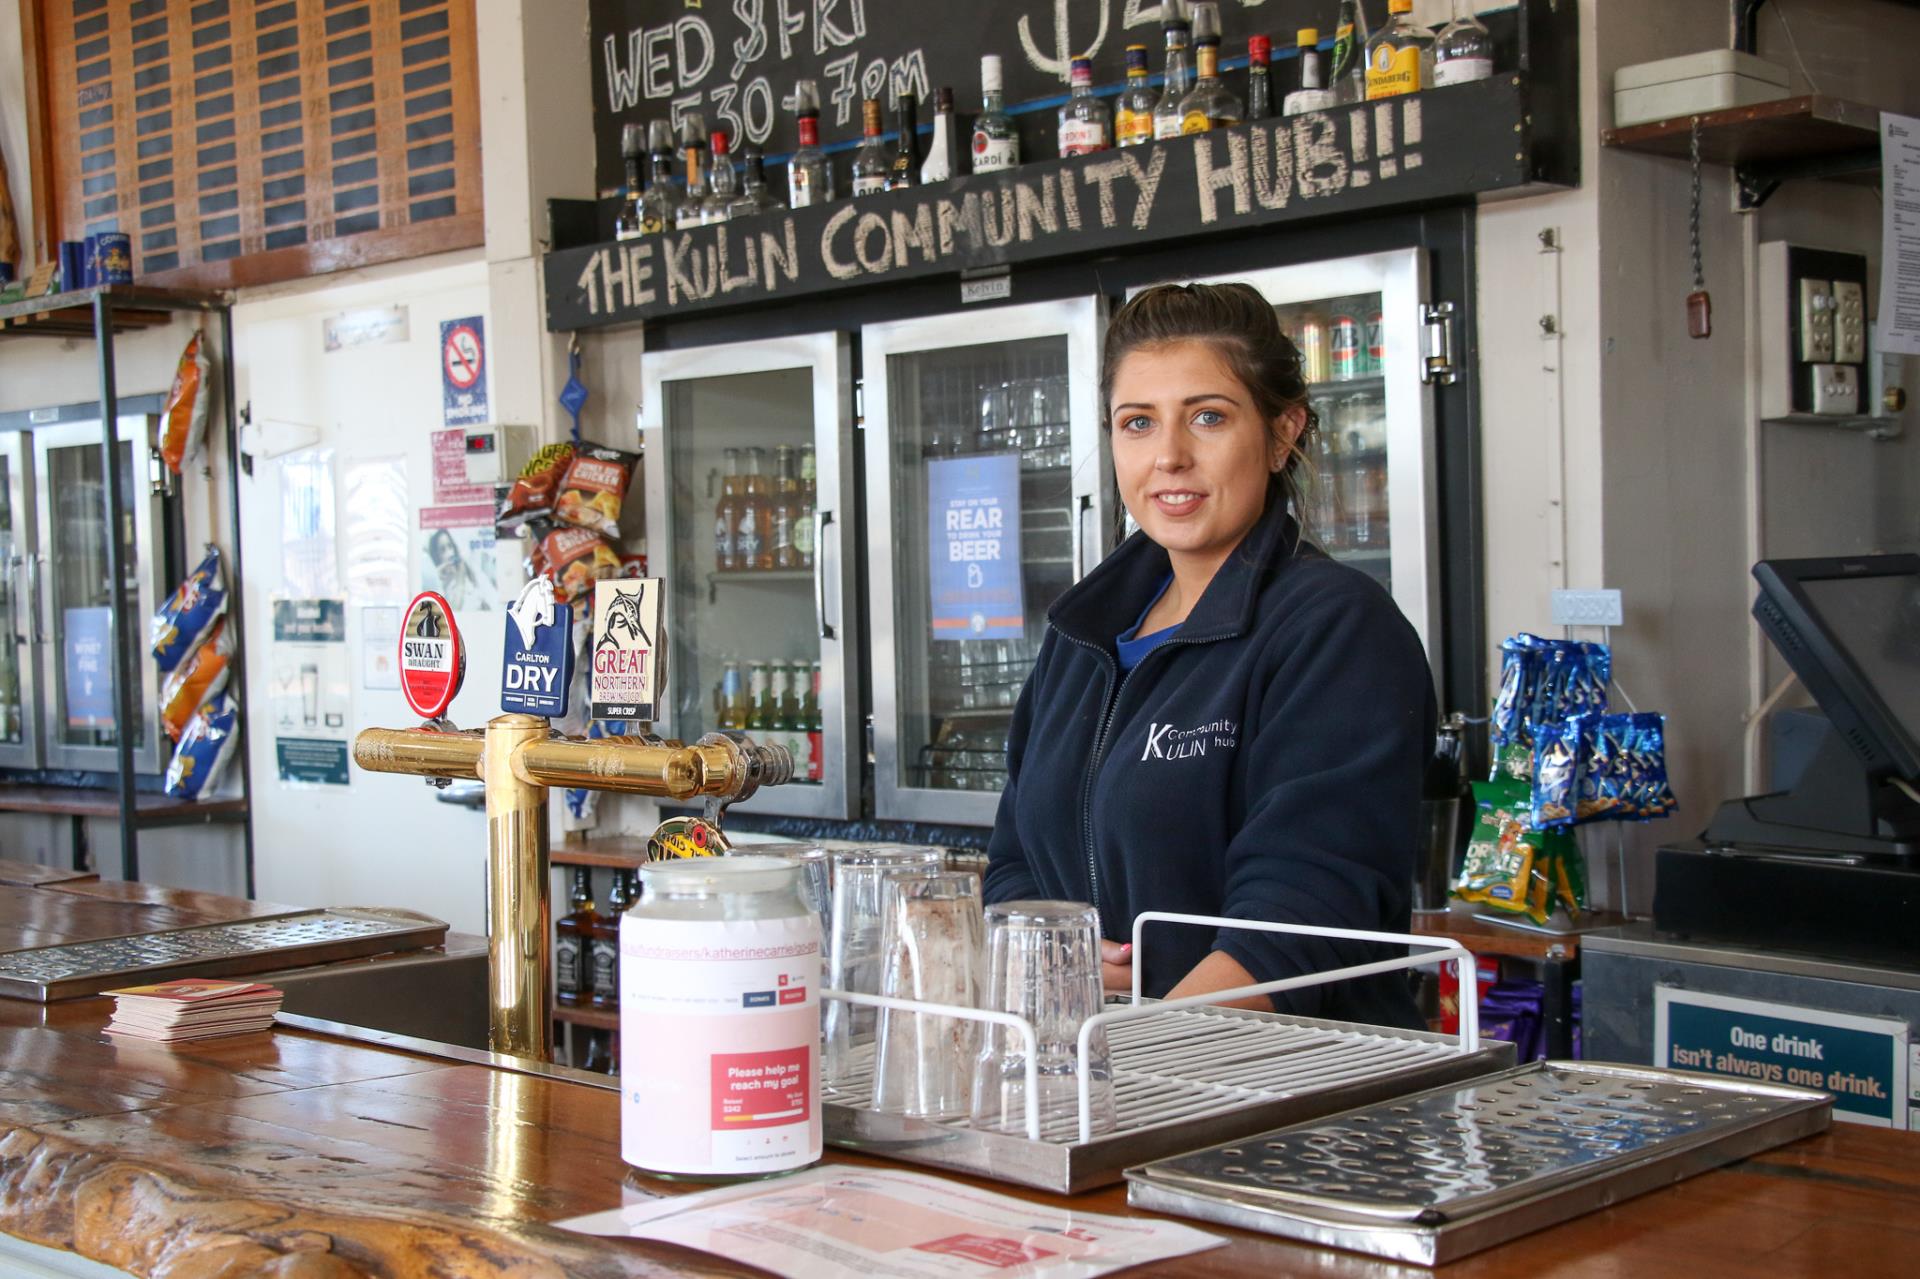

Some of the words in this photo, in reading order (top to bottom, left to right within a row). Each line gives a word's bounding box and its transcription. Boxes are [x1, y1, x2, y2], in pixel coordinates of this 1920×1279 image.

[604, 15, 715, 113] WED
[577, 243, 657, 315] THE
[663, 217, 800, 306] KULIN
[820, 144, 1168, 279] COMMUNITY
[1194, 99, 1424, 225] HUB!!!
[946, 508, 1003, 531] REAR
[949, 539, 1001, 562] BEER
[404, 642, 444, 659] SWAN
[515, 651, 550, 664] CARLTON
[595, 649, 648, 674] GREAT
[408, 658, 440, 669] DRAUGHT
[505, 664, 558, 693] DRY
[594, 676, 646, 690] NORTHERN
[607, 707, 622, 715] SUPER
[1141, 722, 1206, 761] KULIN
[1214, 736, 1236, 748] hub
[1167, 719, 1238, 741] Community
[1730, 1026, 1767, 1047] One
[1772, 1034, 1823, 1060] drink
[728, 1067, 763, 1078] Please
[765, 1064, 787, 1076] help
[787, 1064, 800, 1072] me
[730, 1079, 761, 1091] reach
[764, 1080, 779, 1090] my
[781, 1074, 799, 1089] goal
[1673, 1044, 1712, 1069] isn't
[1716, 1053, 1783, 1081] always
[1787, 1068, 1823, 1088] one
[1828, 1071, 1887, 1099] drink.
